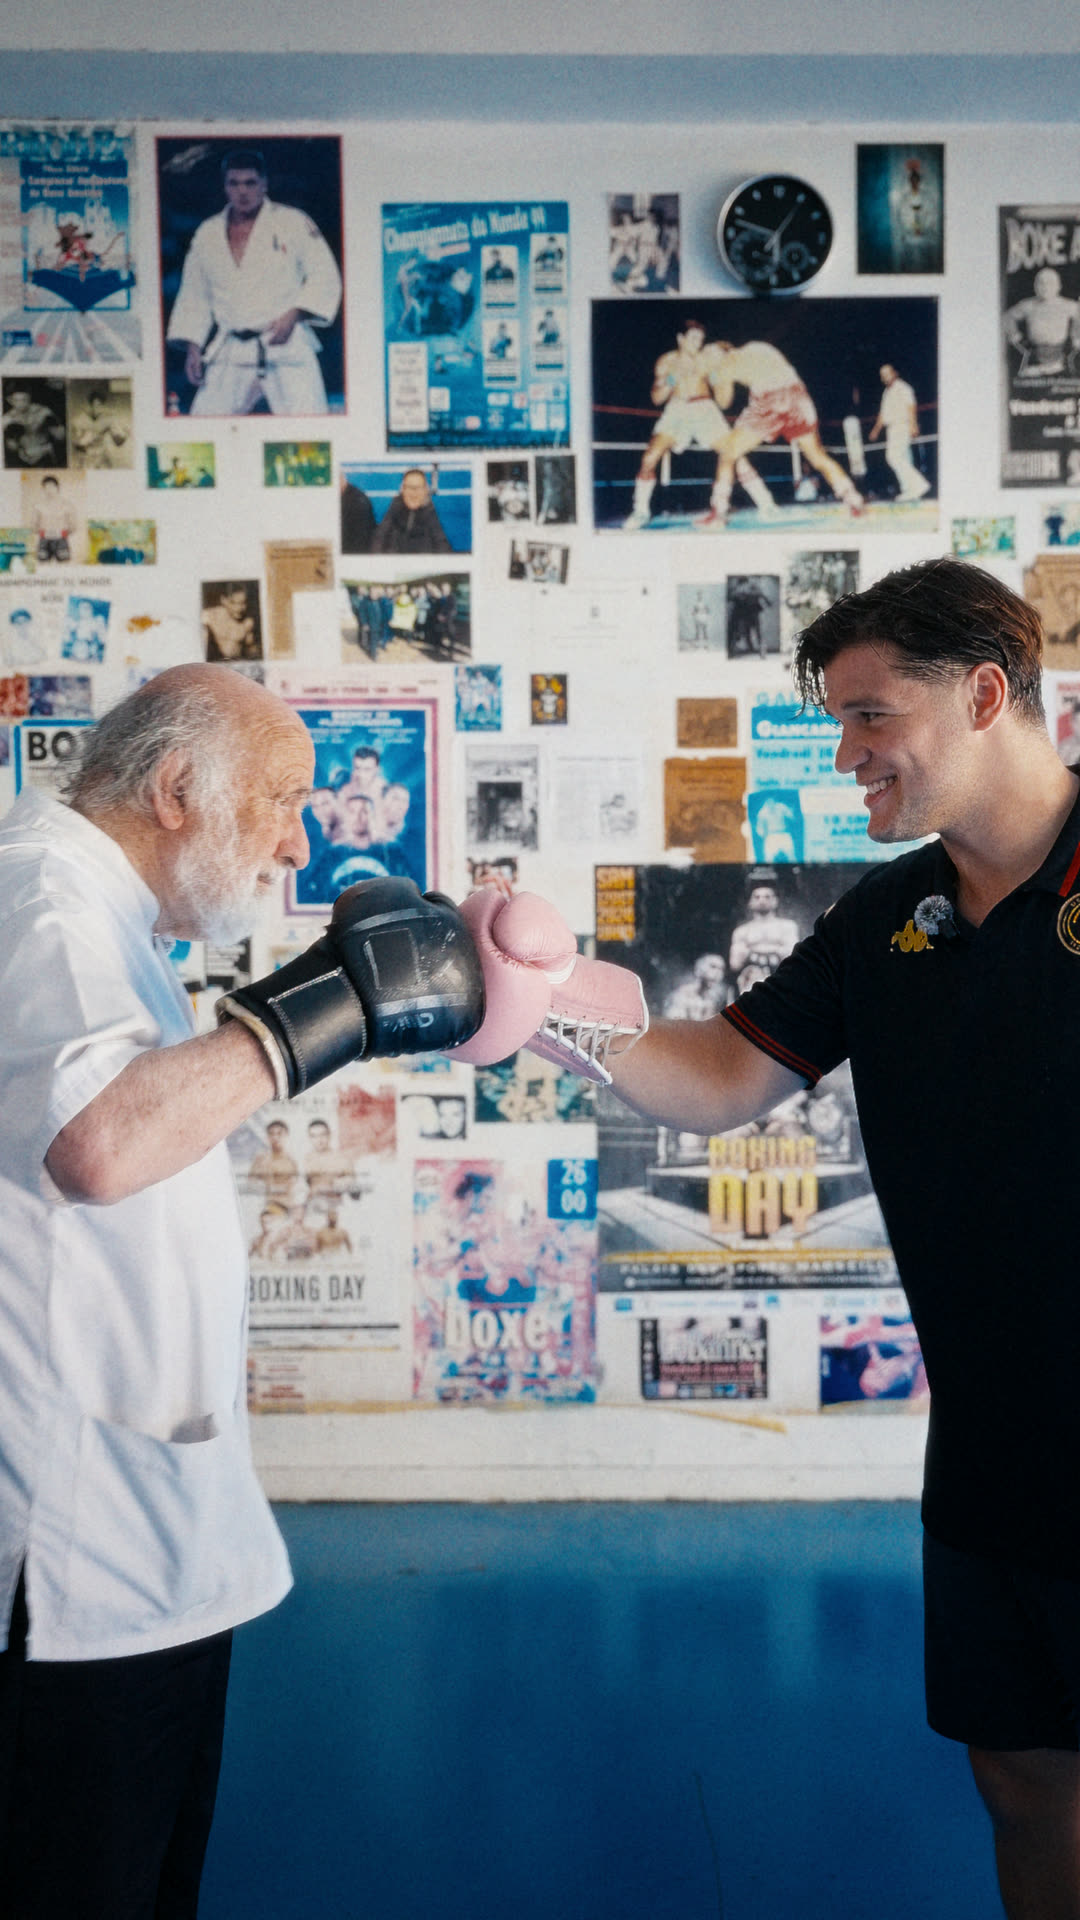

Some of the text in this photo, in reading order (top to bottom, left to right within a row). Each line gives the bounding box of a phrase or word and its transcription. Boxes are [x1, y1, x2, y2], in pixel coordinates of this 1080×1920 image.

[1006, 218, 1068, 274] BOXE
[708, 1136, 817, 1169] BOXING
[561, 1160, 588, 1185] 26
[561, 1189, 588, 1214] 00
[708, 1171, 818, 1235] DAY
[329, 1275, 366, 1301] DAY
[445, 1301, 553, 1351] boxe
